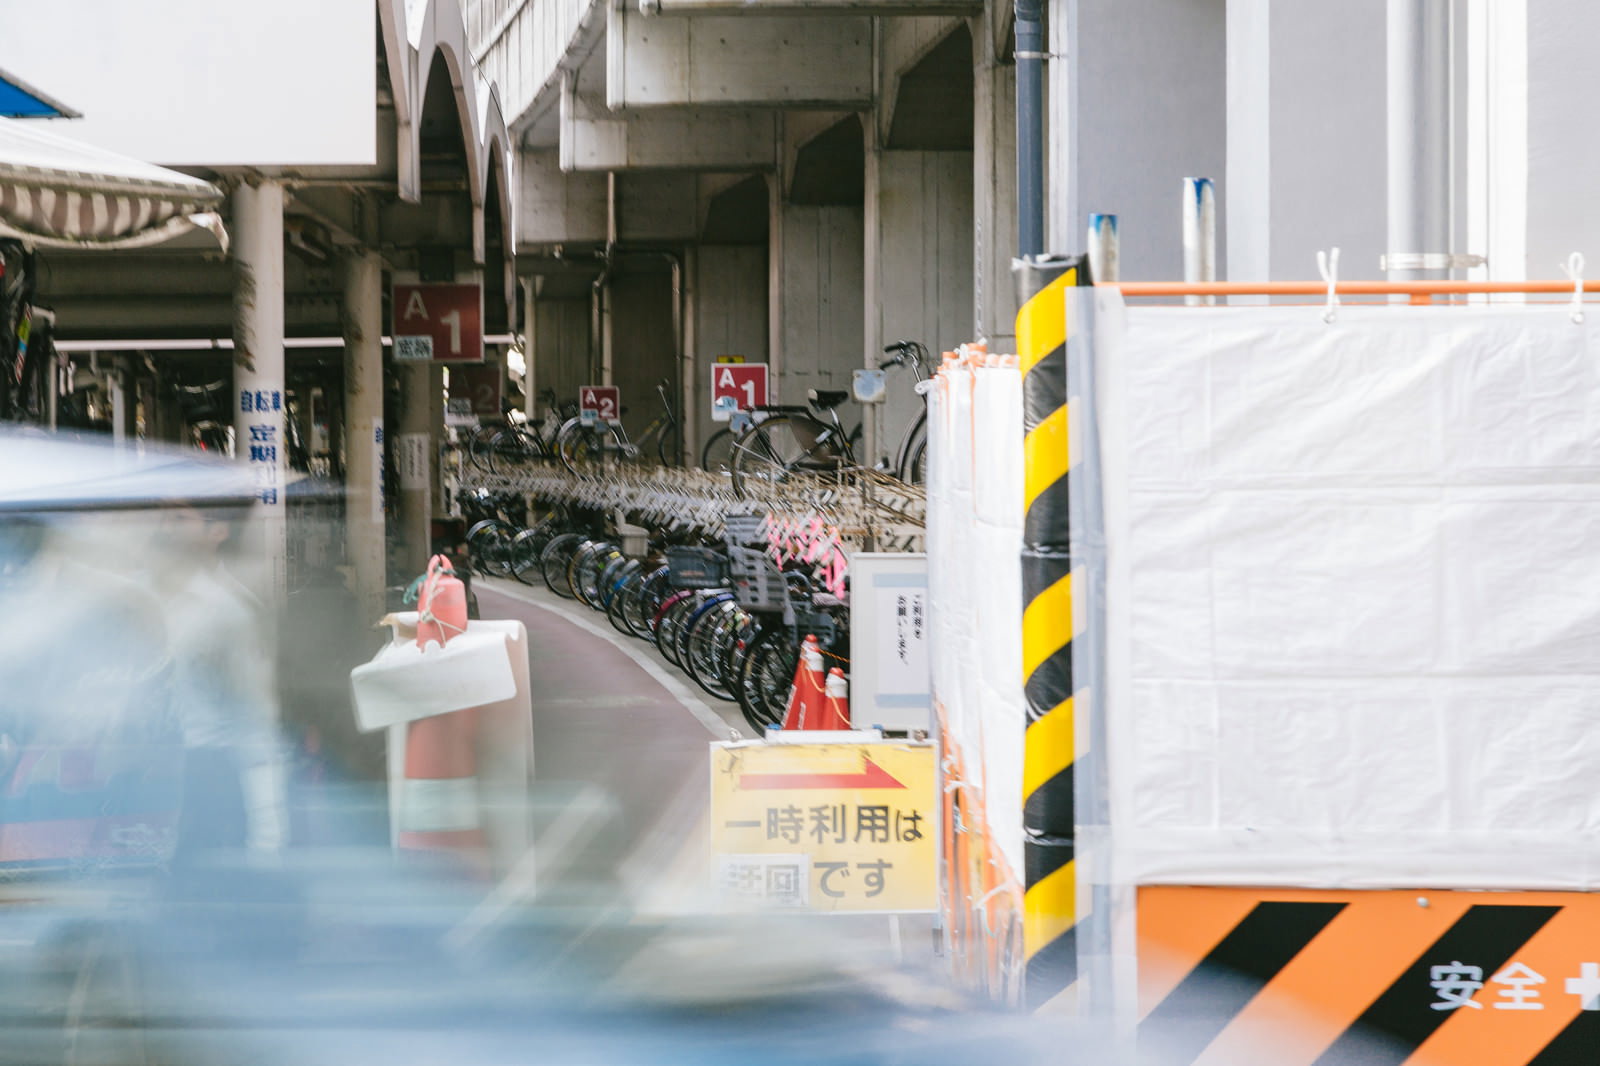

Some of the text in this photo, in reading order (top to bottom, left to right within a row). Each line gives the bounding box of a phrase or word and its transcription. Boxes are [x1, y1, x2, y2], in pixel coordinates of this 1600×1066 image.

[403, 290, 462, 354] A 1
[584, 389, 598, 405] A
[600, 397, 615, 418] 2
[719, 368, 736, 388] A
[741, 380, 755, 408] 1
[724, 803, 923, 844] 一時利用は
[1429, 960, 1547, 1011] 安全
